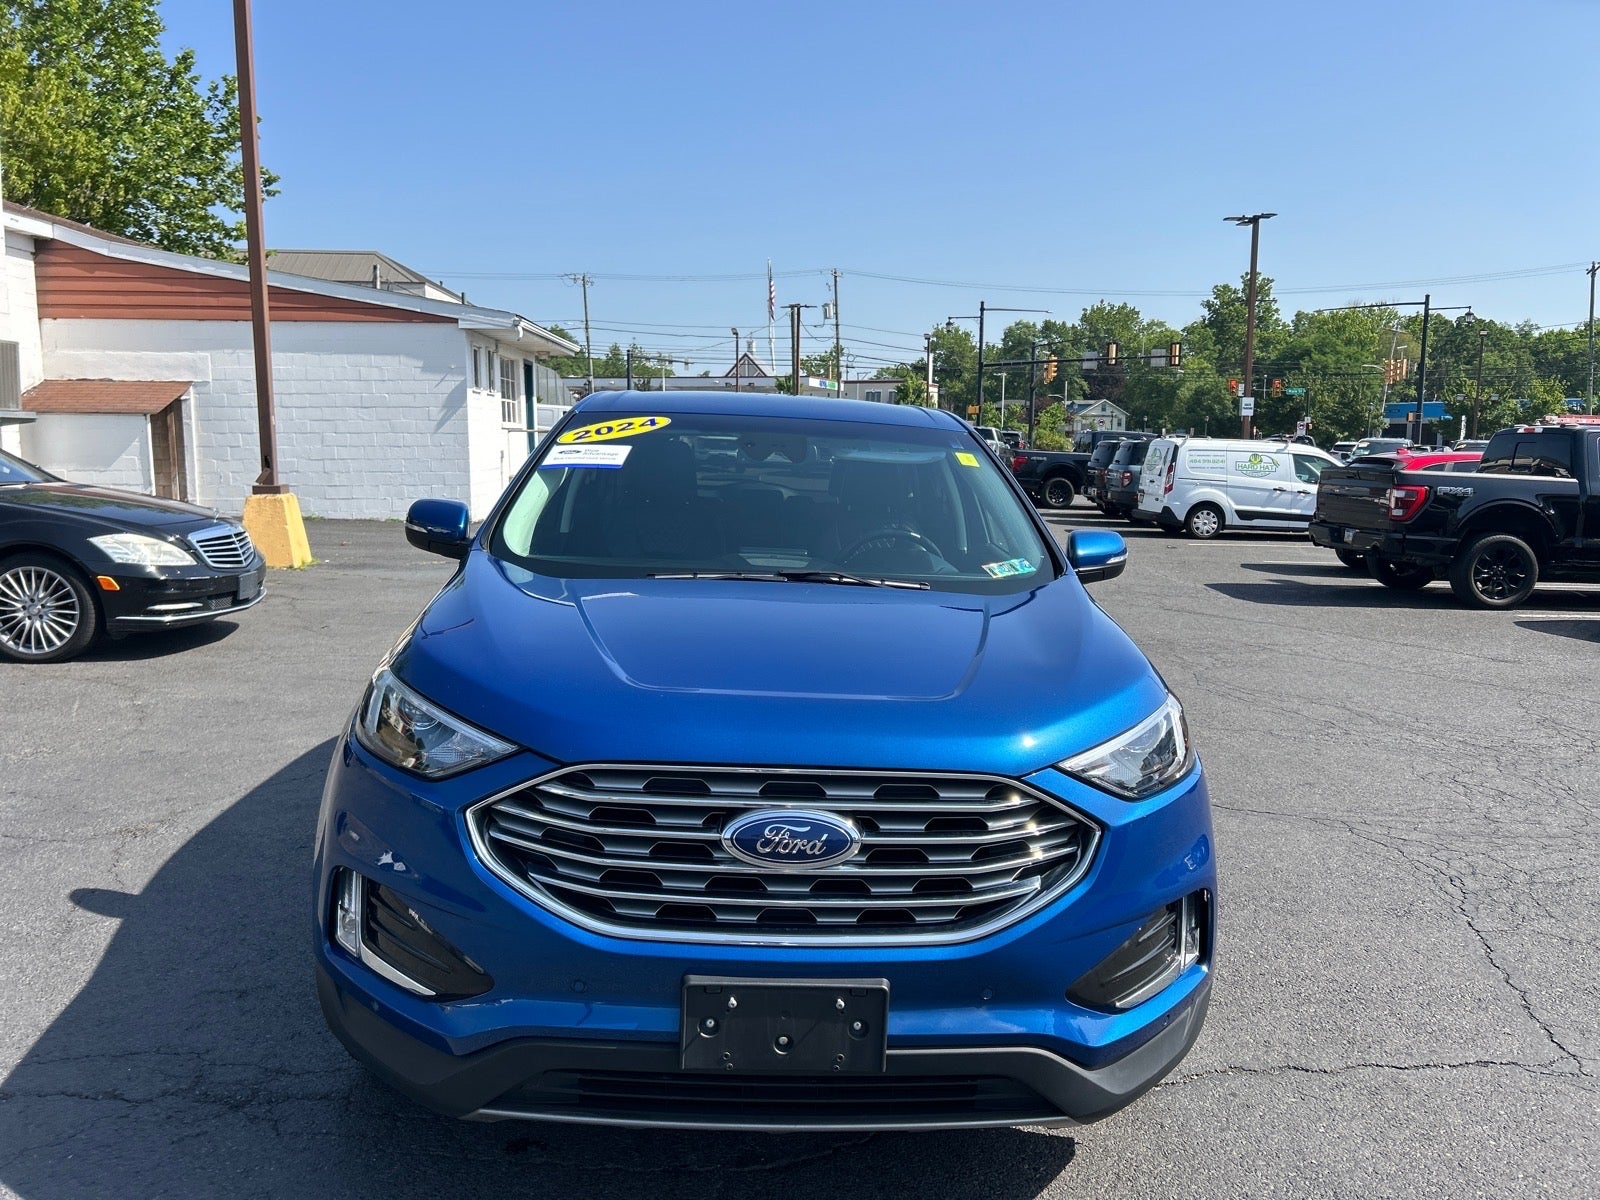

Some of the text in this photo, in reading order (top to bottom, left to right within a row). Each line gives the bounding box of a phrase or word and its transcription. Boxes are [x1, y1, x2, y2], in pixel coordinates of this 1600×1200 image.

[572, 417, 659, 442] 2024
[1437, 486, 1474, 497] FX4
[756, 823, 828, 855] Ford
